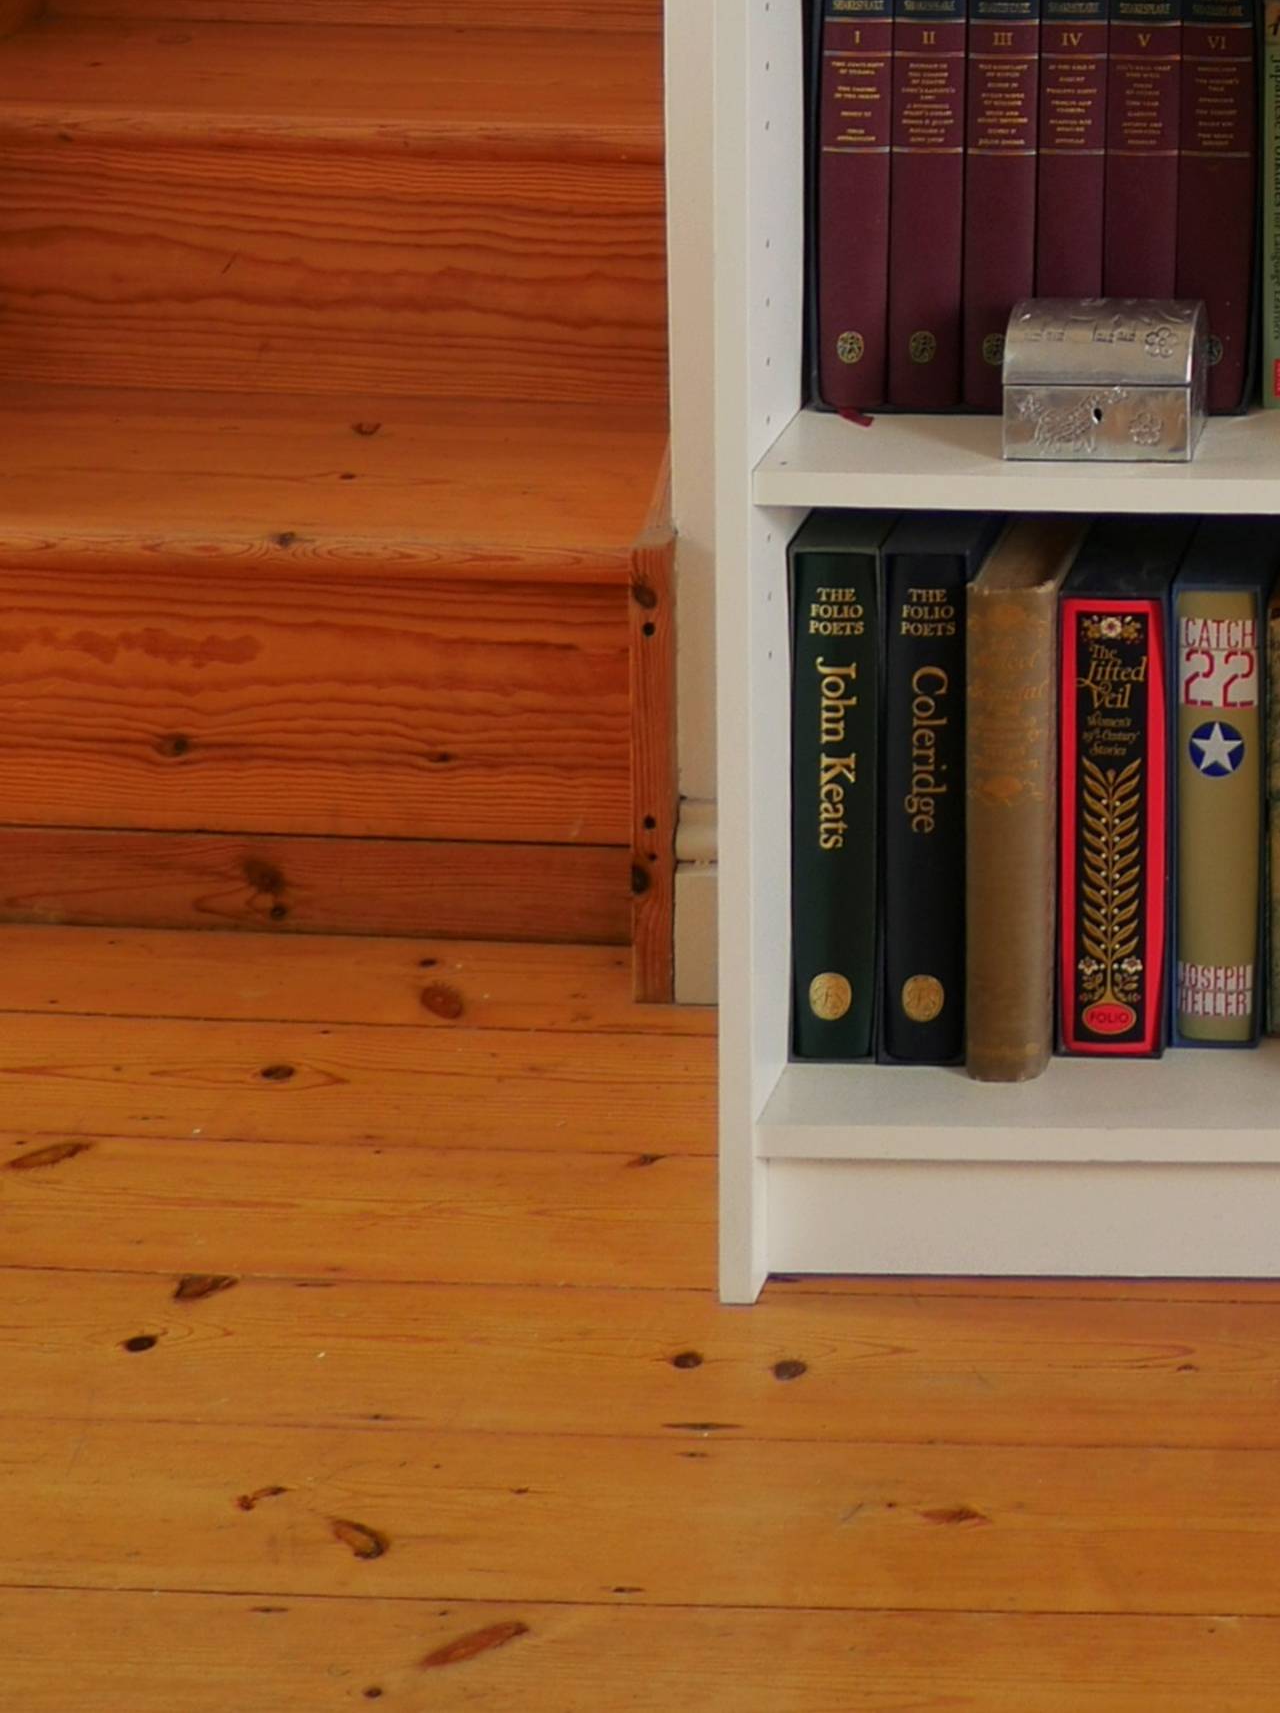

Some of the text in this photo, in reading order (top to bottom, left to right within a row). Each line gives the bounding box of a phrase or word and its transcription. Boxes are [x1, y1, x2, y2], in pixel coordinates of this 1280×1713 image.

[818, 588, 856, 602] THE
[810, 604, 863, 619] FOLIO
[808, 620, 864, 636] POETS
[1181, 618, 1256, 647] CATCH
[1183, 649, 1256, 707] 22
[814, 657, 856, 849] John Keats
[903, 666, 947, 834] Coleridge
[1178, 965, 1248, 989] JOSEPH
[1179, 992, 1250, 1016] HELLER
[1091, 1012, 1130, 1024] FOLIO
